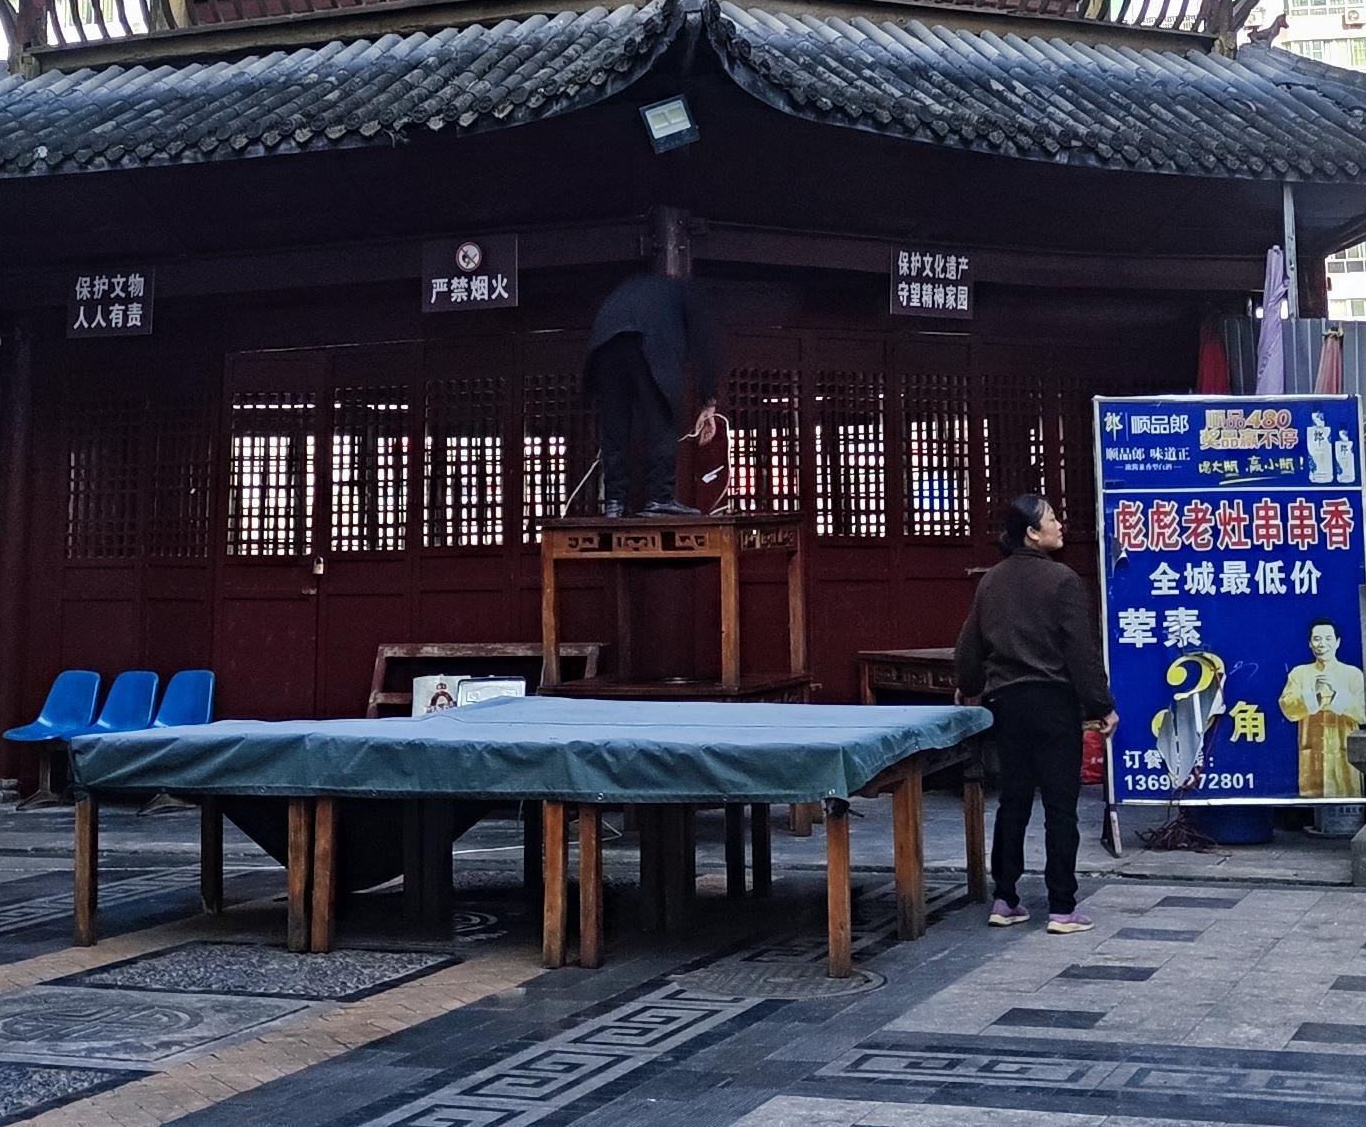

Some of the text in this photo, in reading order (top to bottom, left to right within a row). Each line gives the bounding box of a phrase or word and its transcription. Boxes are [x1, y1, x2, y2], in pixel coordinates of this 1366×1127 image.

[898, 250, 969, 280] 保护文化遗产
[75, 273, 145, 301] 保护文物
[430, 273, 509, 304] 严禁烟火
[897, 281, 969, 311] 守望精神家园
[73, 302, 143, 330] 人人有责
[1130, 414, 1189, 434] 顺品郎
[1205, 409, 1292, 429] 顺品480
[1199, 428, 1299, 450] 奖品赢不停
[1105, 446, 1190, 461] 顺品郎 味道正
[1114, 497, 1355, 553] 彪彪老灶串串香
[1149, 560, 1323, 596] 全城最低价
[1118, 606, 1203, 649] 荤素
[1123, 749, 1214, 769] 订餐：
[1124, 773, 1254, 791] 136972801
